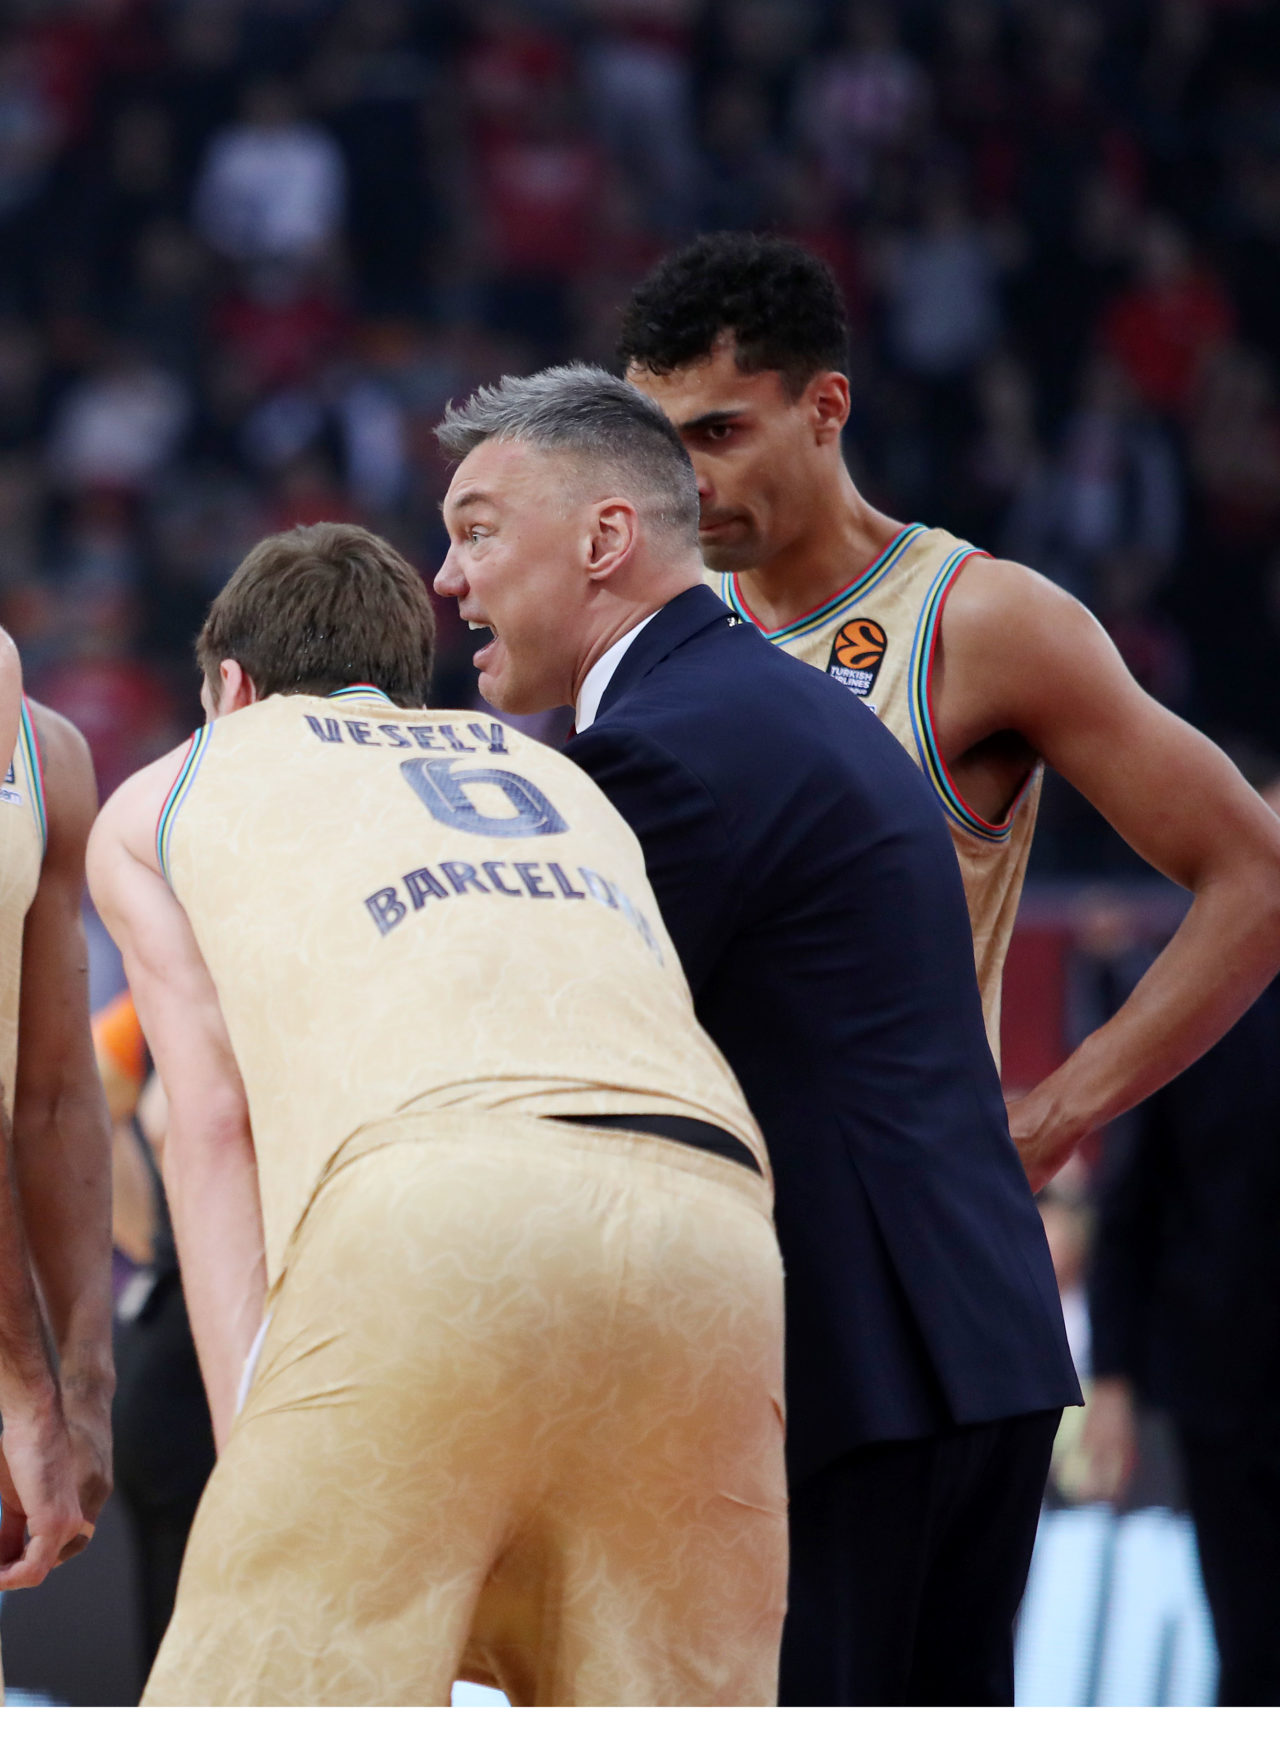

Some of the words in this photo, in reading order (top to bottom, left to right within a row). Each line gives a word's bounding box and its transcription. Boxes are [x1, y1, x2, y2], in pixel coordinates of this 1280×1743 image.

[830, 665, 874, 682] TURKISH
[830, 675, 870, 689] IRLINES
[303, 714, 510, 755] VESELY
[400, 757, 570, 839] 6
[364, 860, 665, 969] BARCELO
